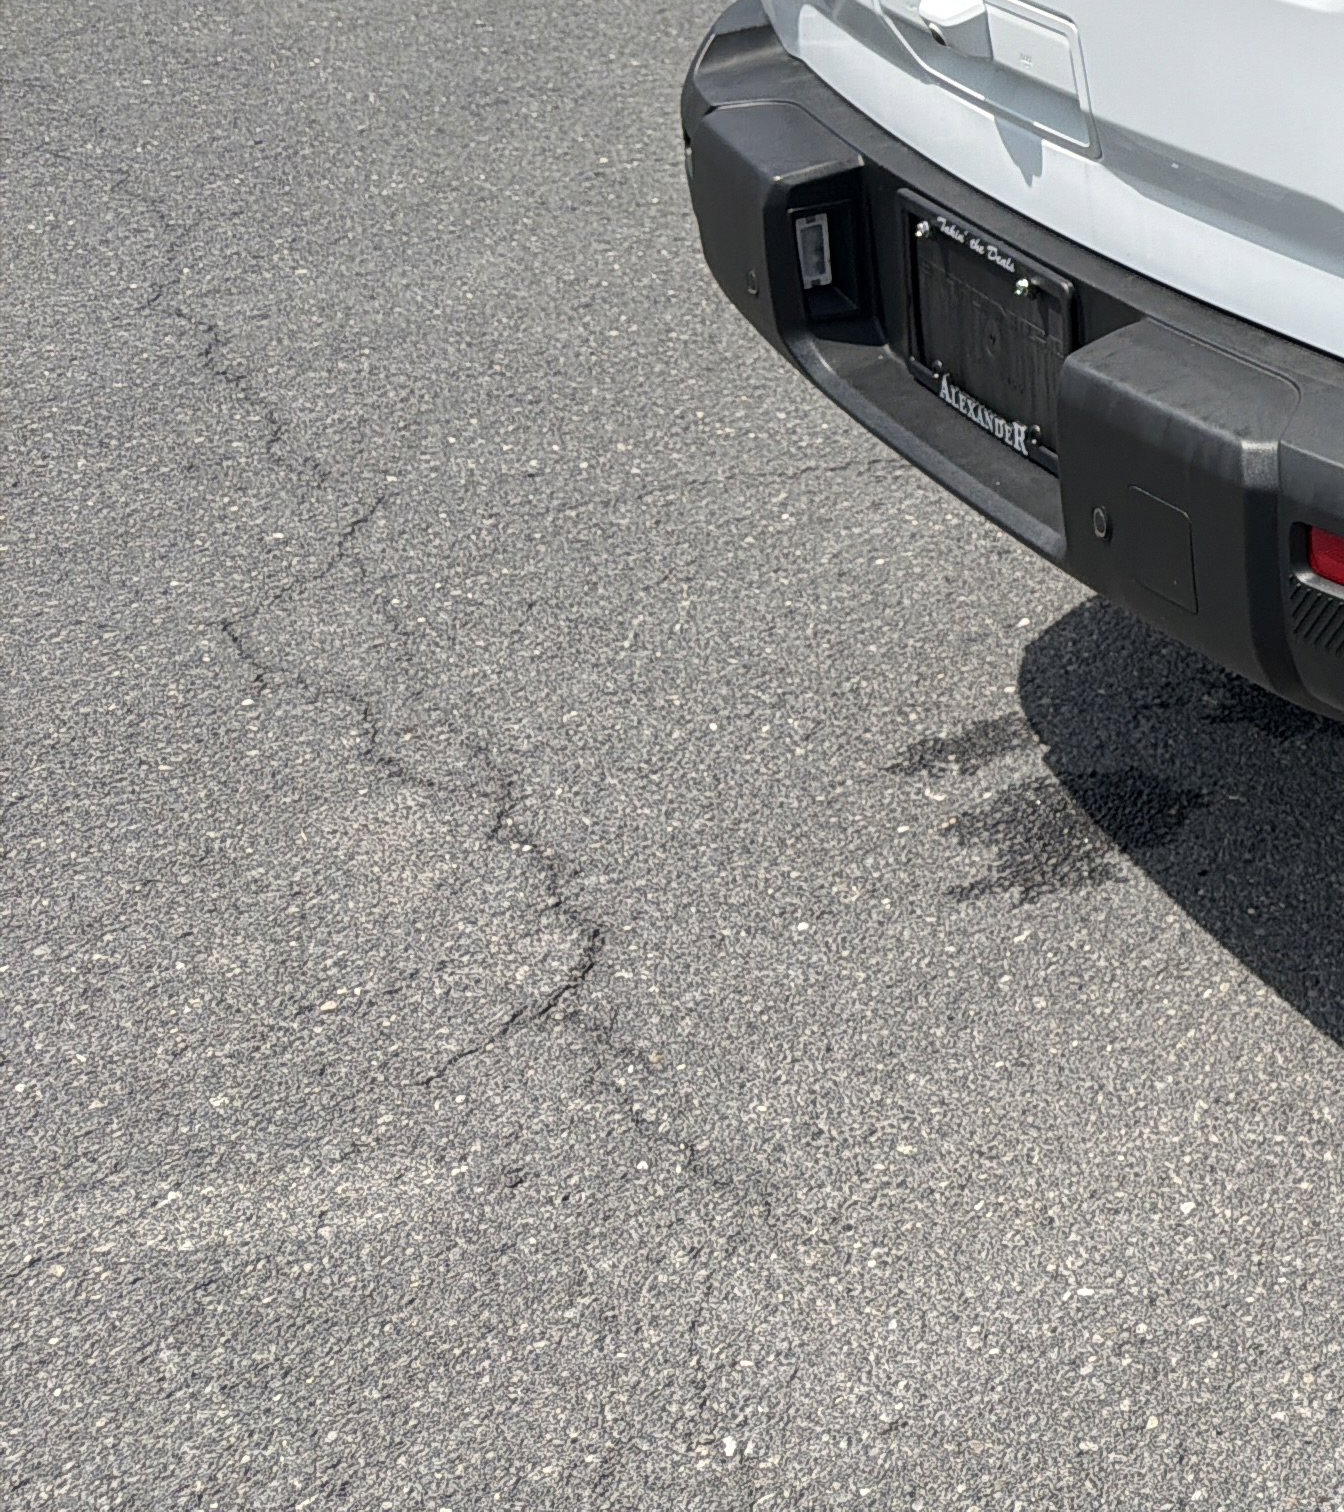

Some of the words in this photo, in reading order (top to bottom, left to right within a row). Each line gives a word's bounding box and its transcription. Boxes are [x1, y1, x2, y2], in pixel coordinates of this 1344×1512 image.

[969, 238, 985, 255] the
[987, 245, 1015, 272] Deals
[940, 373, 1028, 456] ALEXANDER
